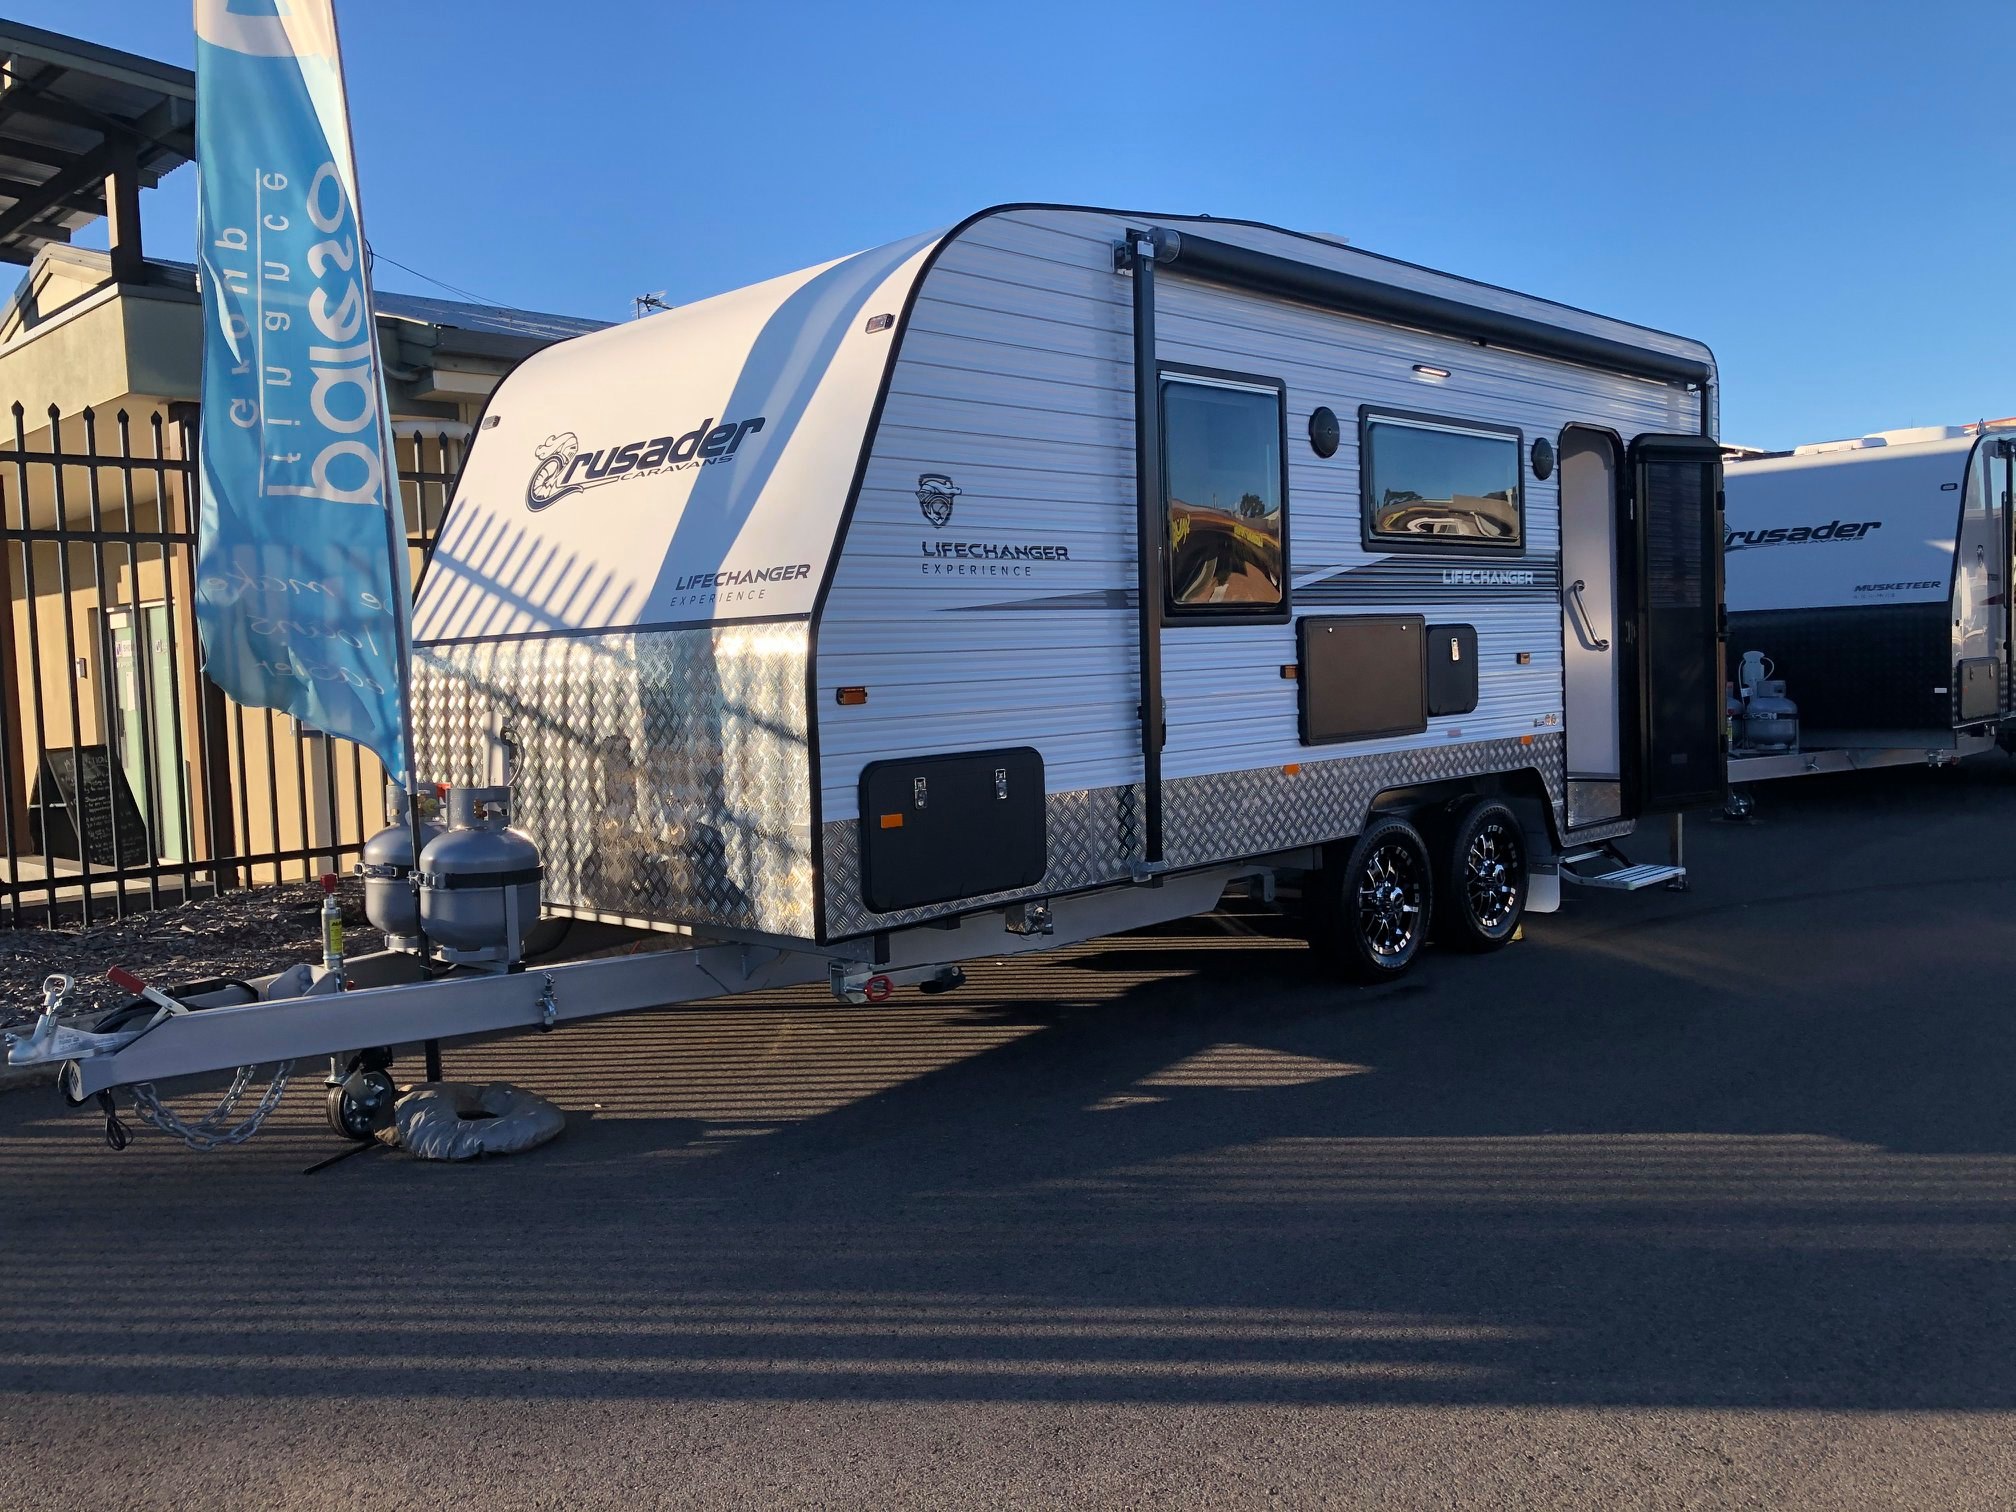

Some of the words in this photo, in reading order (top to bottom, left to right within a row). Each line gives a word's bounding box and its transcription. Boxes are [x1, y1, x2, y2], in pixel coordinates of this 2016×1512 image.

[620, 454, 733, 481] CARAVANS
[1725, 520, 1882, 547] rusader
[922, 541, 1070, 560] LIFECHANGER
[675, 564, 811, 591] LIFECHANGER
[922, 563, 1031, 576] EXPERIENCE
[1442, 570, 1534, 584] LIFECHANGER
[1854, 581, 1942, 592] MUSKETEER
[670, 589, 765, 606] EXPERIENCE
